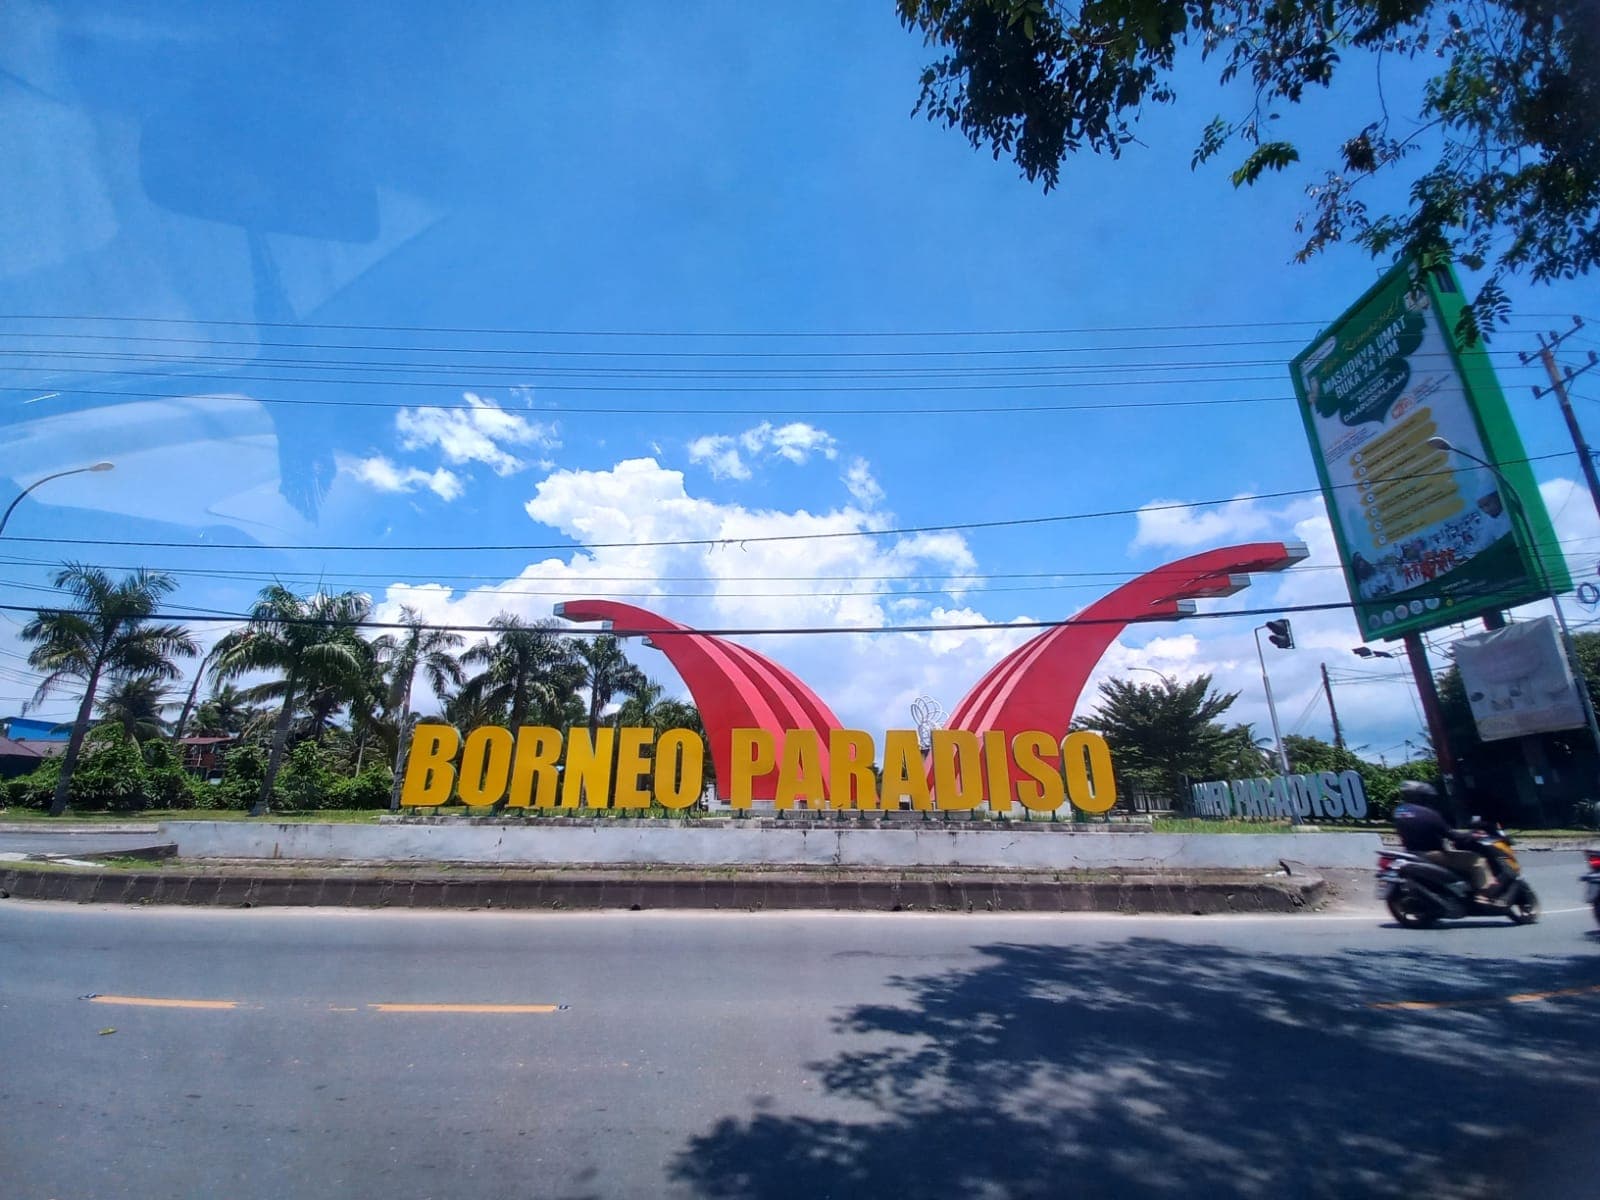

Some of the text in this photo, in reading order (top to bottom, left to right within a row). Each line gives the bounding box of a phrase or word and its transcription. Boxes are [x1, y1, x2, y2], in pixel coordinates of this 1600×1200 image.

[1322, 344, 1375, 394] MASJIDNYA
[1376, 314, 1406, 349] UMAT
[1335, 372, 1361, 399] BUKA
[1362, 359, 1376, 378] 24
[1377, 339, 1399, 365] JAM
[401, 724, 1117, 813] BORNEO PARADISO
[1232, 770, 1368, 818] PARADISO
